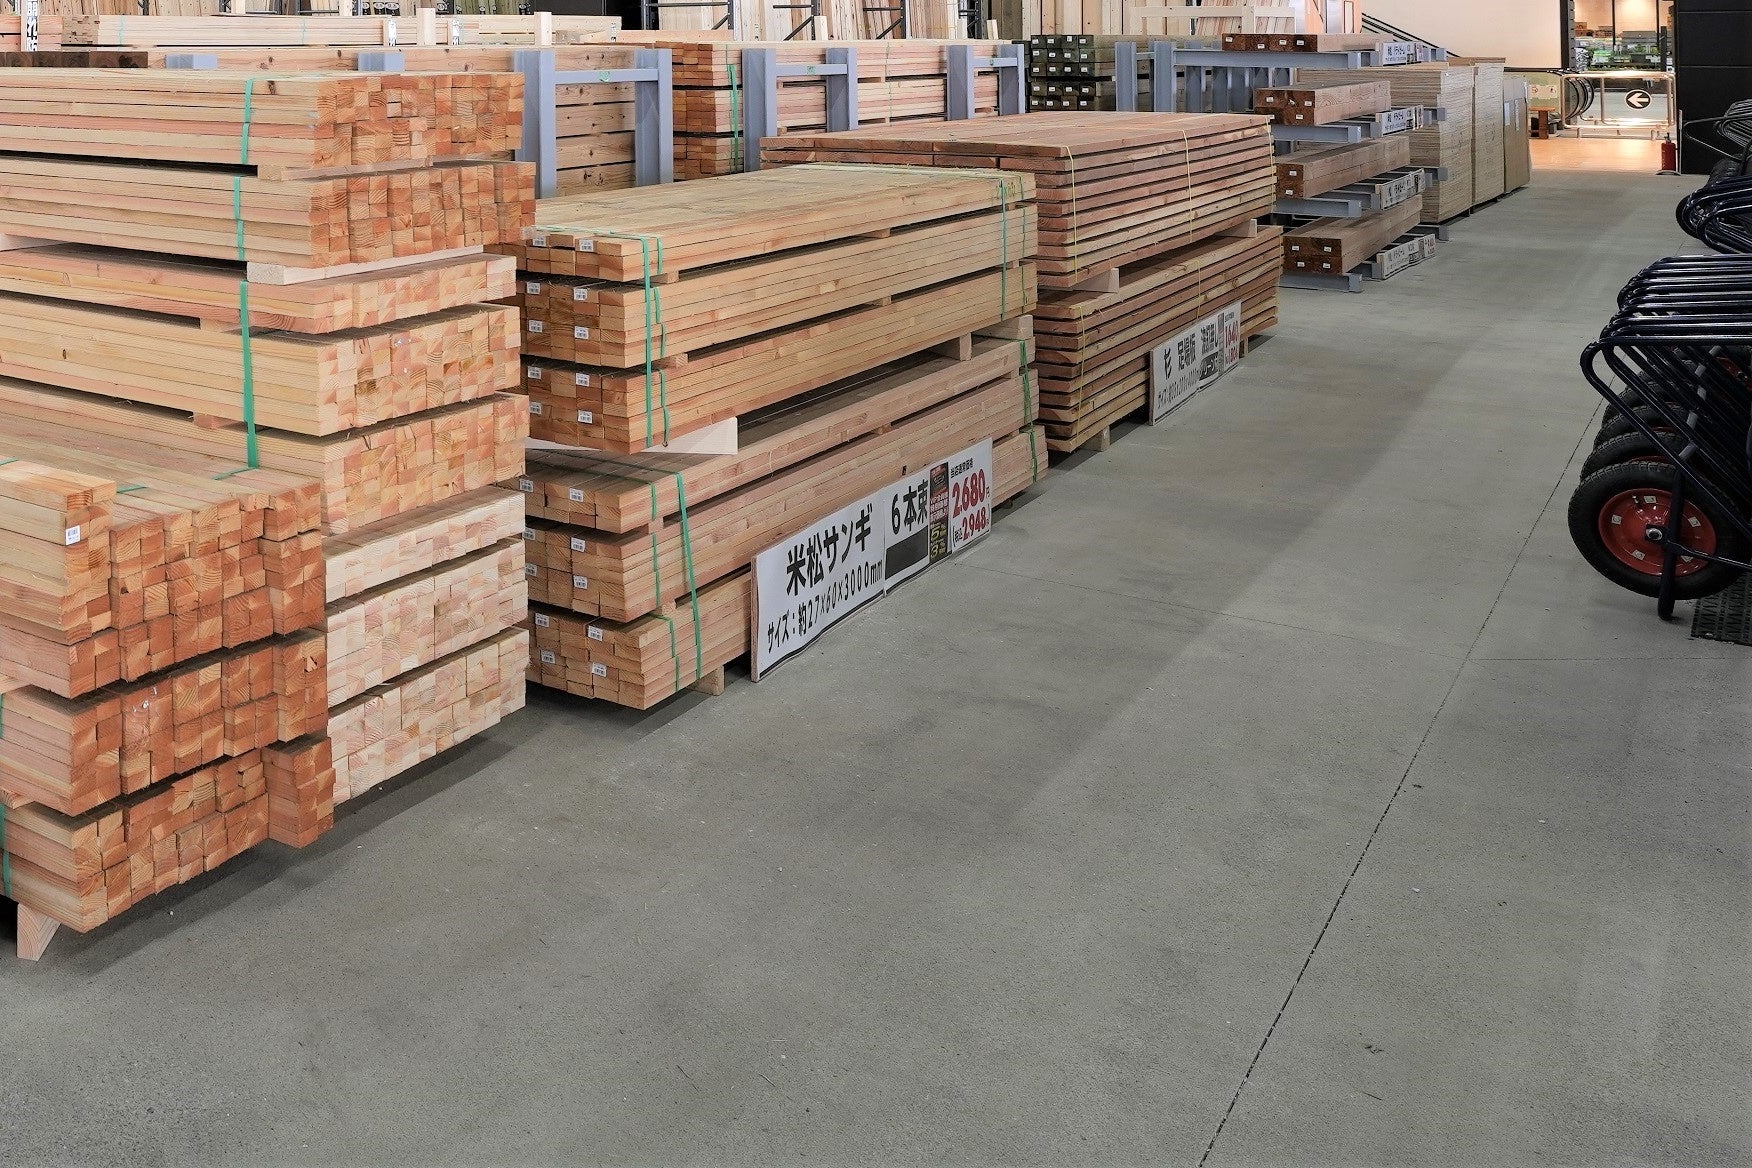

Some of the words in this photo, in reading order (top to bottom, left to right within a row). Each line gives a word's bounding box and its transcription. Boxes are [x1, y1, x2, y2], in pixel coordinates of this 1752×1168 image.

[786, 503, 873, 597] 米松サンギ
